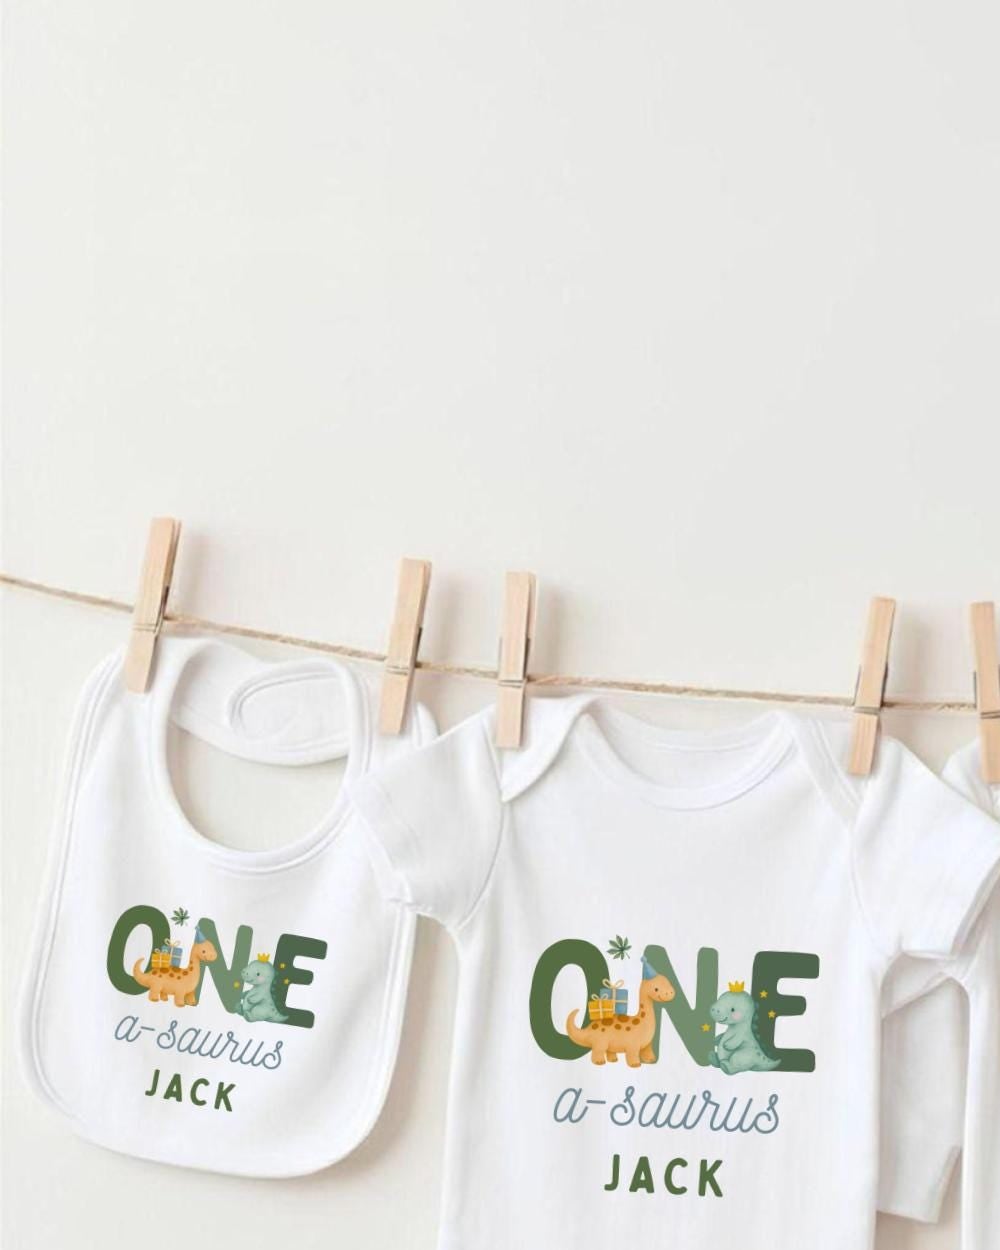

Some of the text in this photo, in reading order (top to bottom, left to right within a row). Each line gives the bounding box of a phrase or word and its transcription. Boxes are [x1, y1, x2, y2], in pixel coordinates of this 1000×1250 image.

[107, 905, 327, 1029] ONE
[529, 939, 820, 1073] ONE
[115, 1015, 283, 1070] a-saurus
[145, 1069, 236, 1112] JACK
[553, 1088, 779, 1135] a-saurus
[603, 1154, 723, 1198] JACK
